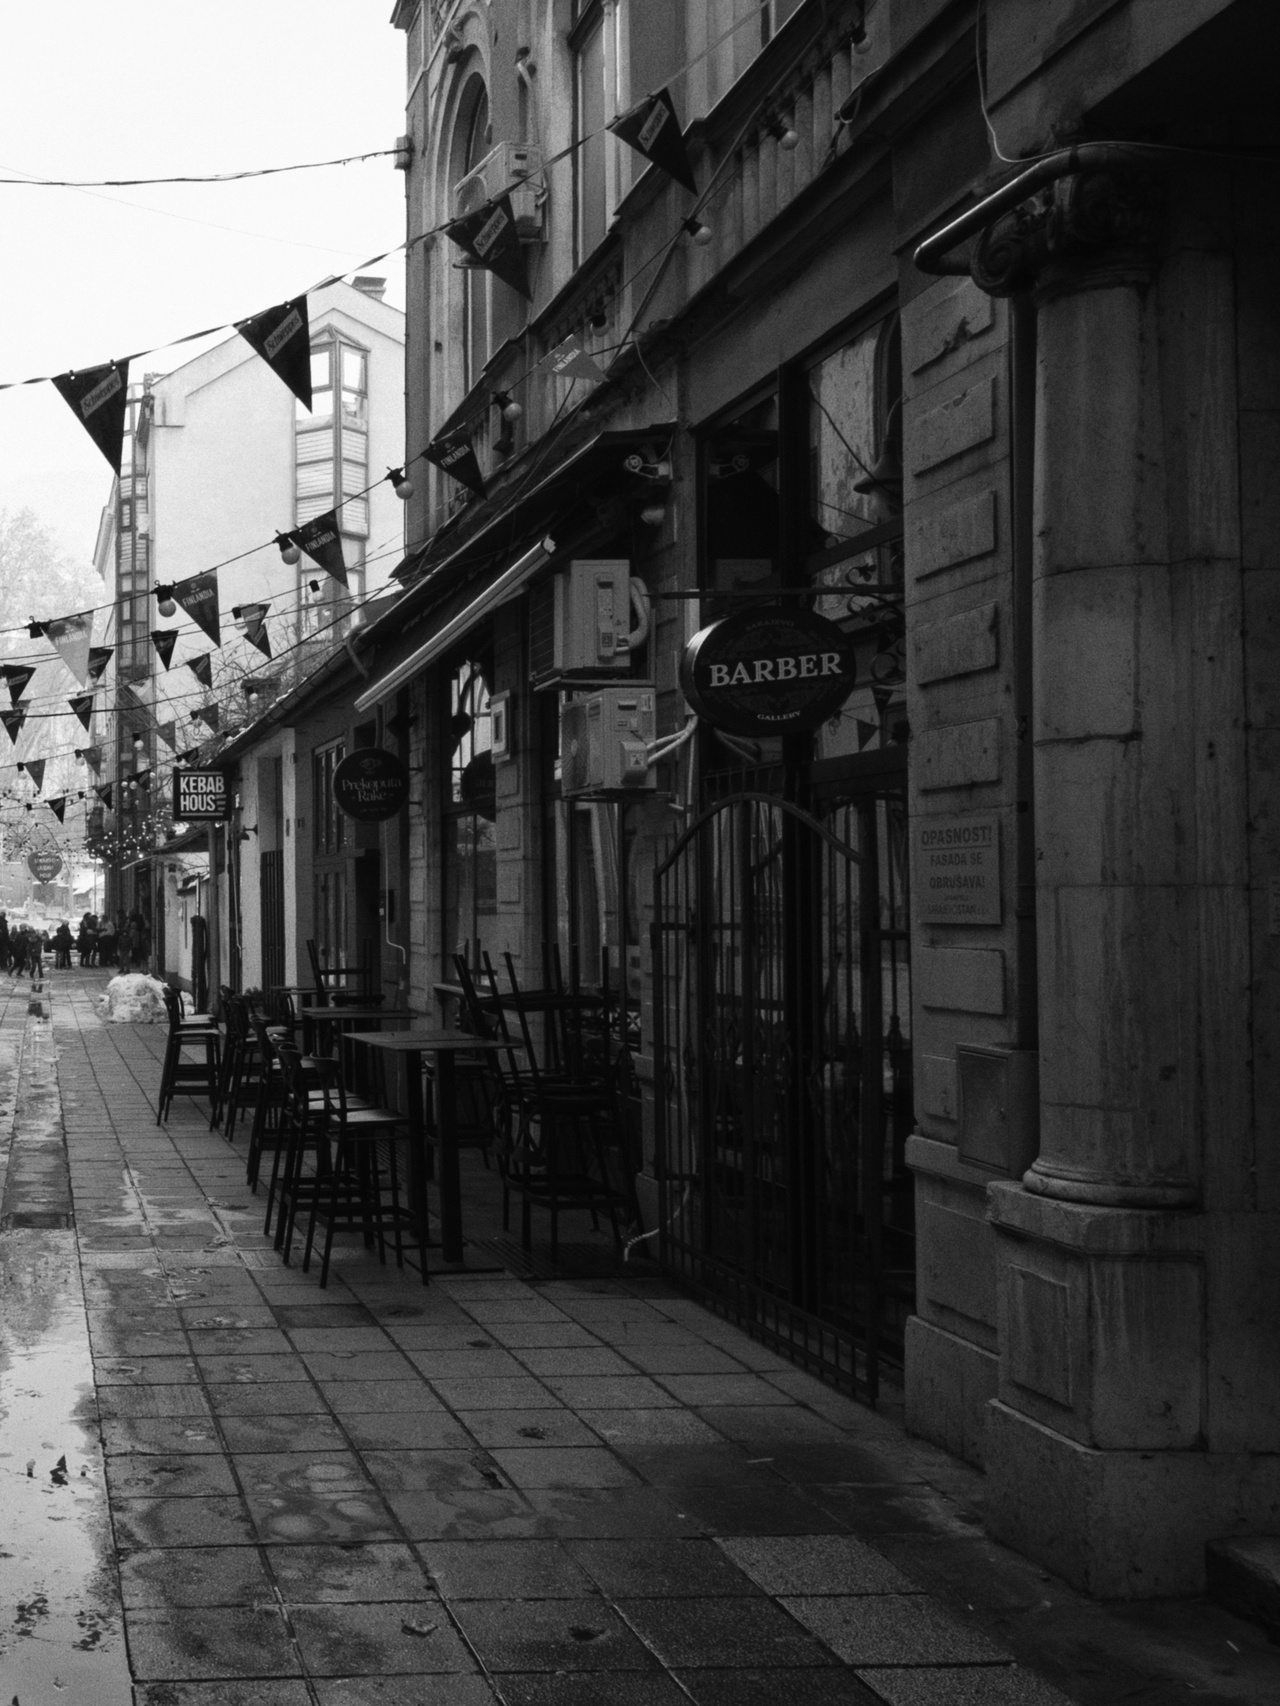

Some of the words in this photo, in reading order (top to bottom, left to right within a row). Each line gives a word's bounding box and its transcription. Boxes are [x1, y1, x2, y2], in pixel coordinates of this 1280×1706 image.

[552, 348, 582, 374] FINLANDIA
[440, 444, 472, 469] FINLANDIA
[304, 530, 337, 553] FINLANDIA
[181, 588, 215, 608] FINLANDIA
[745, 618, 795, 631] SARAJEVO
[709, 652, 843, 688] BARBER
[757, 709, 802, 722] GALLERY
[180, 776, 225, 793] KEBAB
[342, 778, 402, 791] Prekoputa
[358, 789, 387, 802] Rake
[922, 825, 992, 846] OPASNOST!
[930, 853, 967, 866] FASADA
[970, 852, 983, 865] SE
